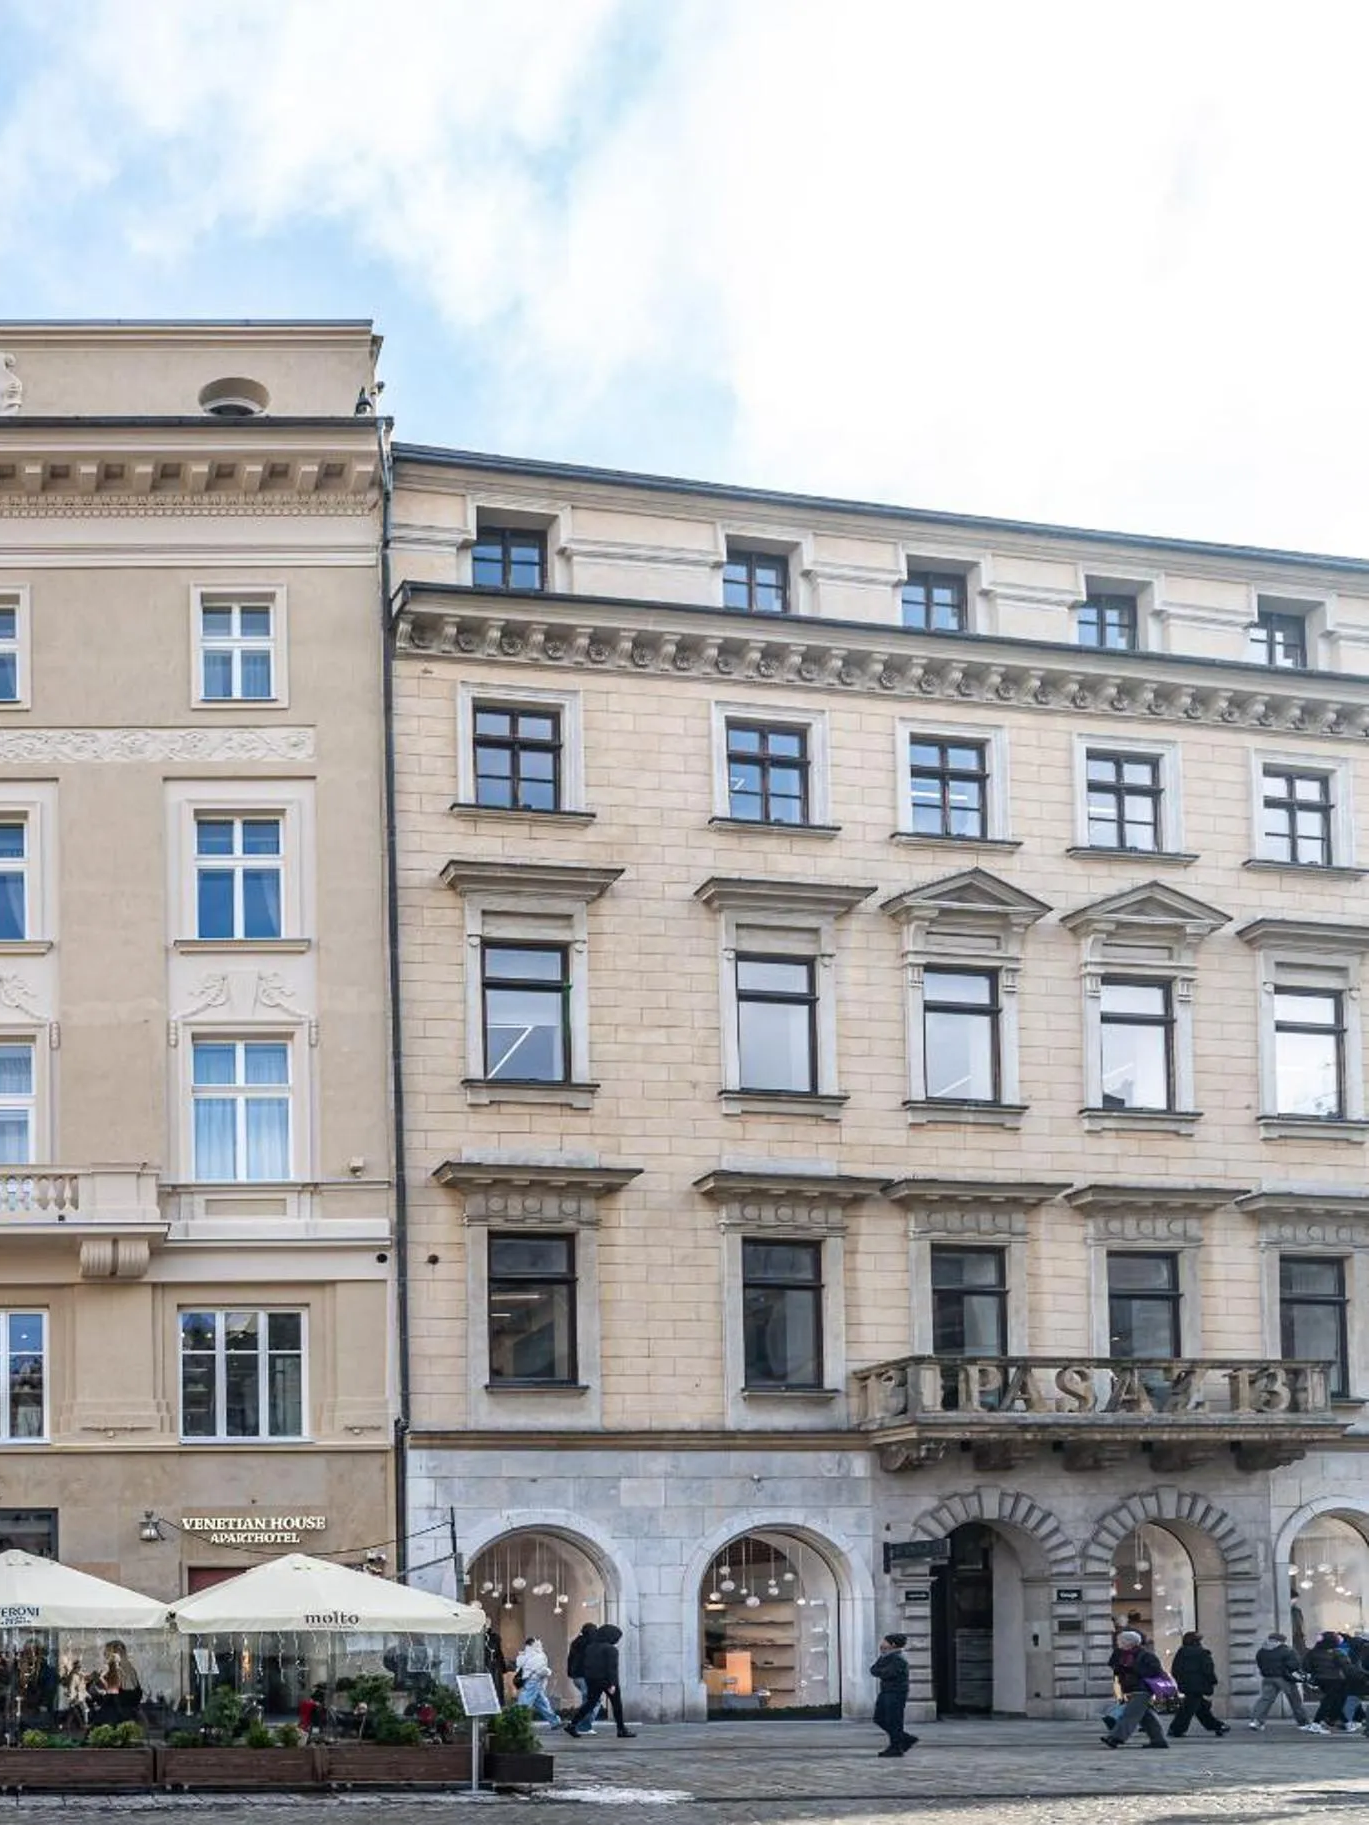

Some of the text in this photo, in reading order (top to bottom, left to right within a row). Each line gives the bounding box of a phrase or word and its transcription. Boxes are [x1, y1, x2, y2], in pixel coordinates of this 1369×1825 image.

[1225, 1366, 1291, 1413] 13
[181, 1516, 327, 1530] VENETIAN HOUSE
[210, 1532, 301, 1544] APARTHOTEL
[303, 1610, 359, 1624] molto
